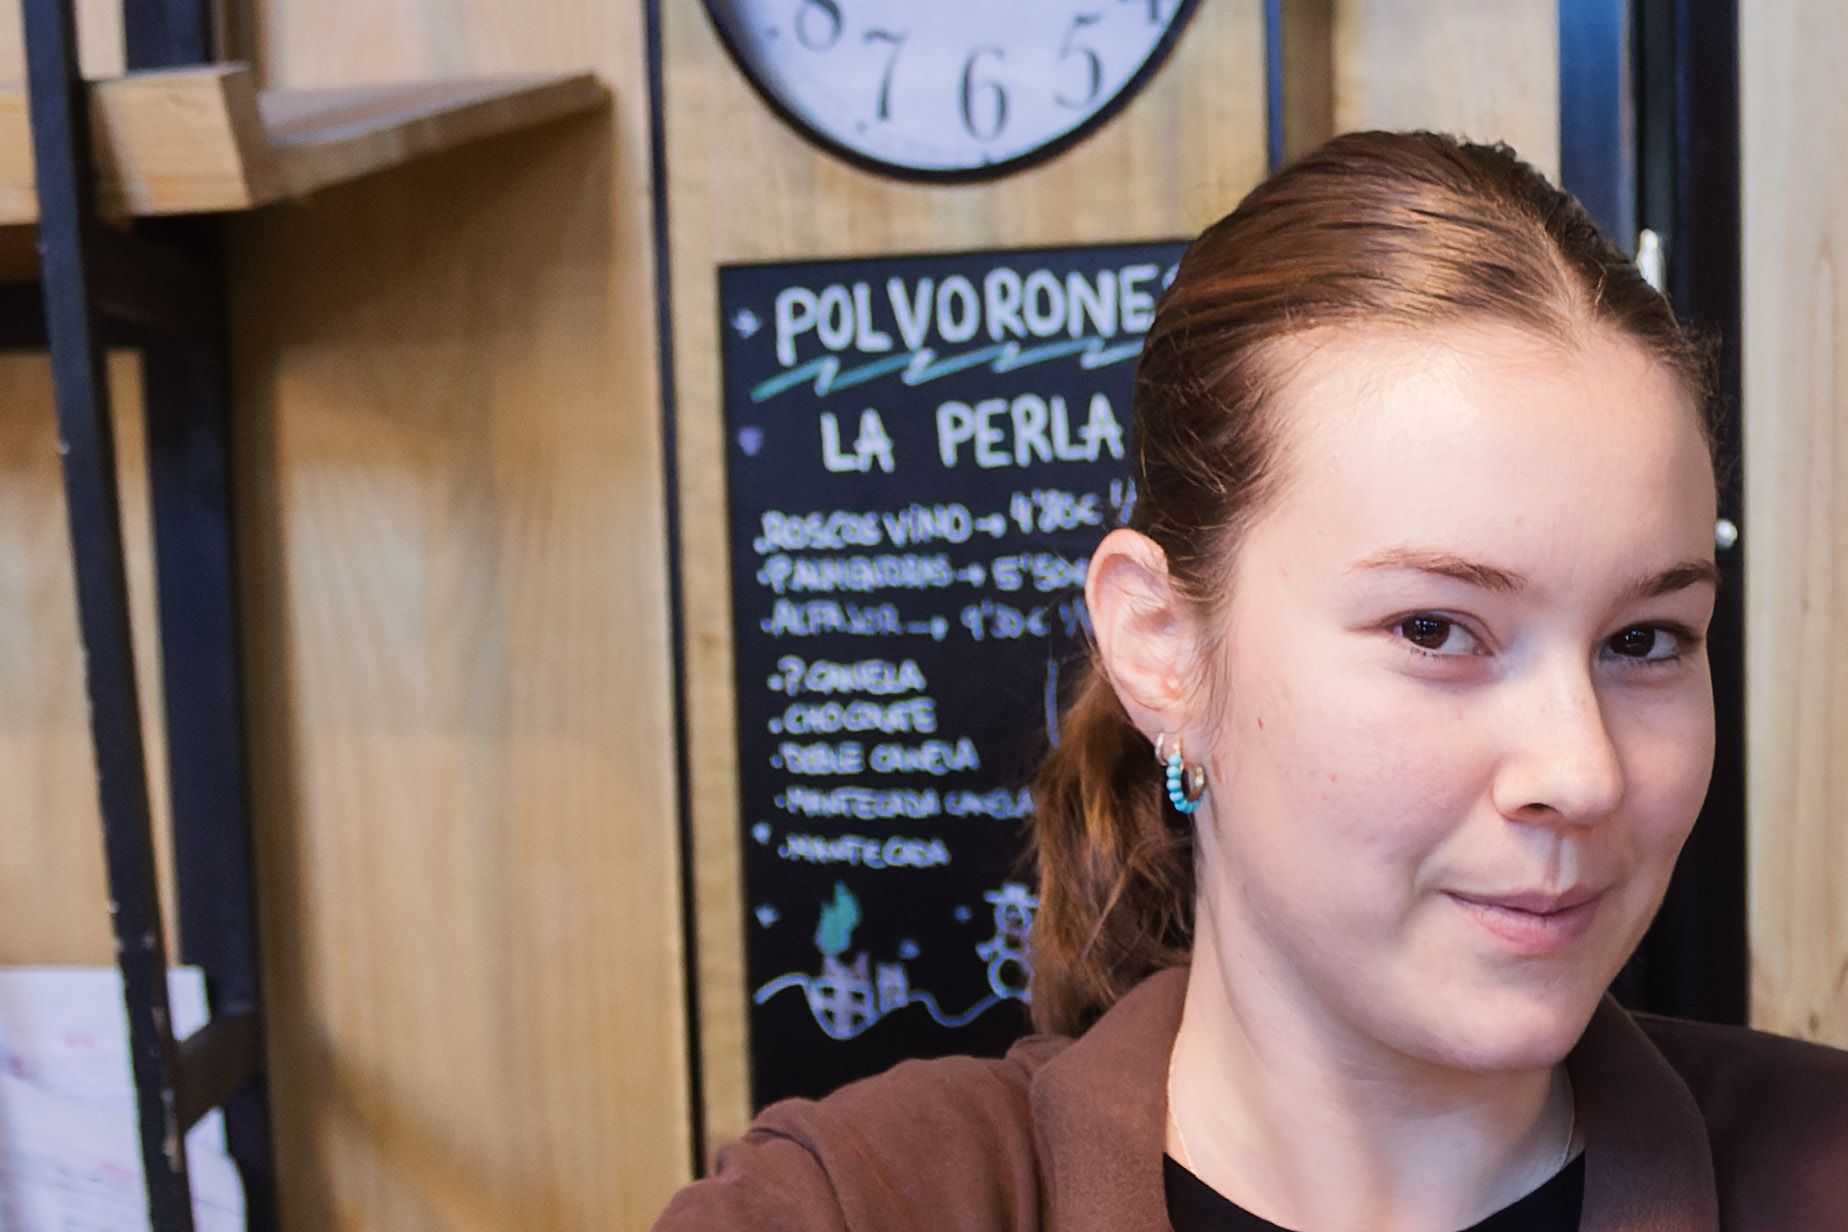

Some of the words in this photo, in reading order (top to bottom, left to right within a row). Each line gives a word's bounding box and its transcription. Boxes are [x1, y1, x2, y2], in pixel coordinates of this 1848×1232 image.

[863, 25, 903, 121] 7
[958, 44, 1008, 142] 6
[1054, 13, 1104, 108] 5
[775, 263, 1180, 367] POLVORONE
[820, 408, 895, 473] LA
[936, 393, 1124, 468] PERLA
[882, 502, 973, 548] VINO
